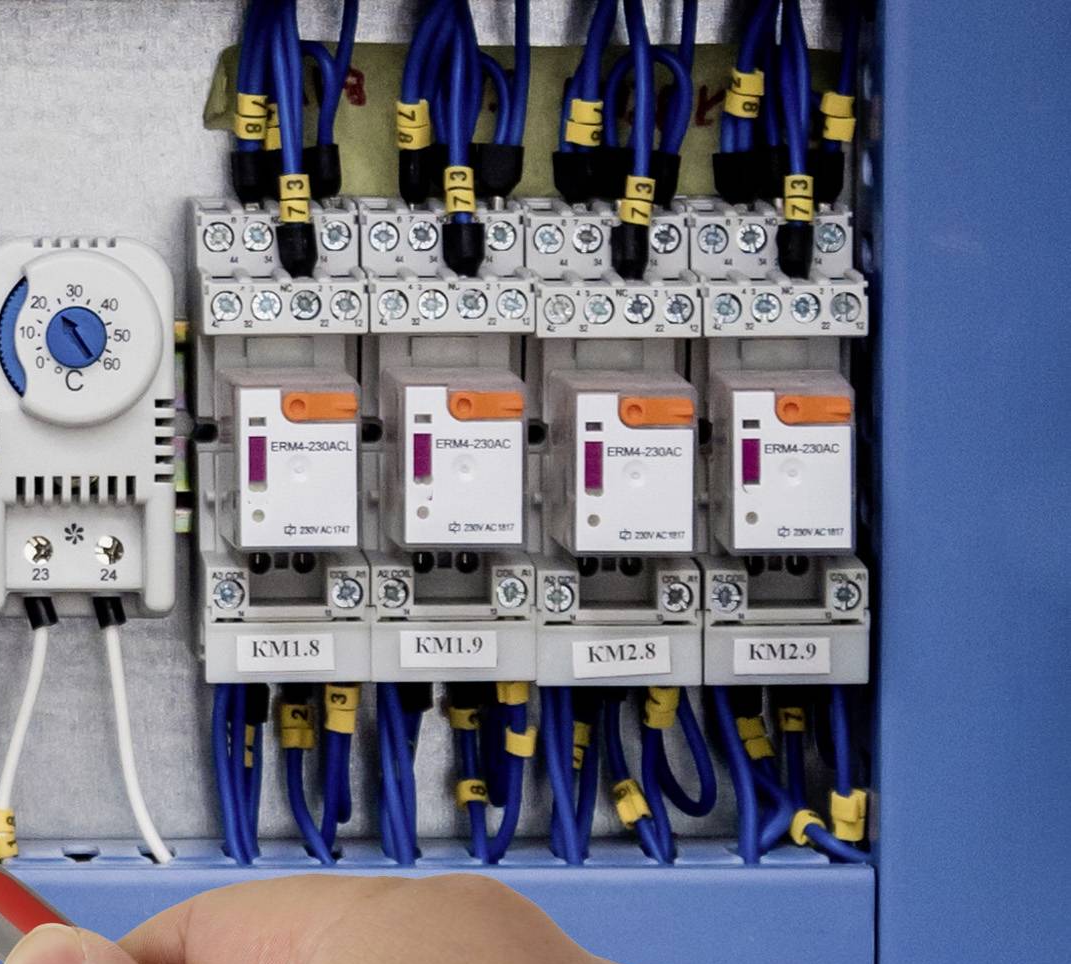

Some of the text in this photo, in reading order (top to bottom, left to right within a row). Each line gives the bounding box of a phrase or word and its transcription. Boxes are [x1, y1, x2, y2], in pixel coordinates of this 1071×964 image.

[66, 284, 83, 297] 30
[30, 296, 47, 309] 20
[100, 298, 119, 312] 40
[19, 326, 35, 339] 10
[114, 329, 131, 342] 50
[35, 356, 45, 369] 0
[103, 357, 121, 371] 60
[32, 568, 50, 581] 23
[100, 568, 117, 581] 24
